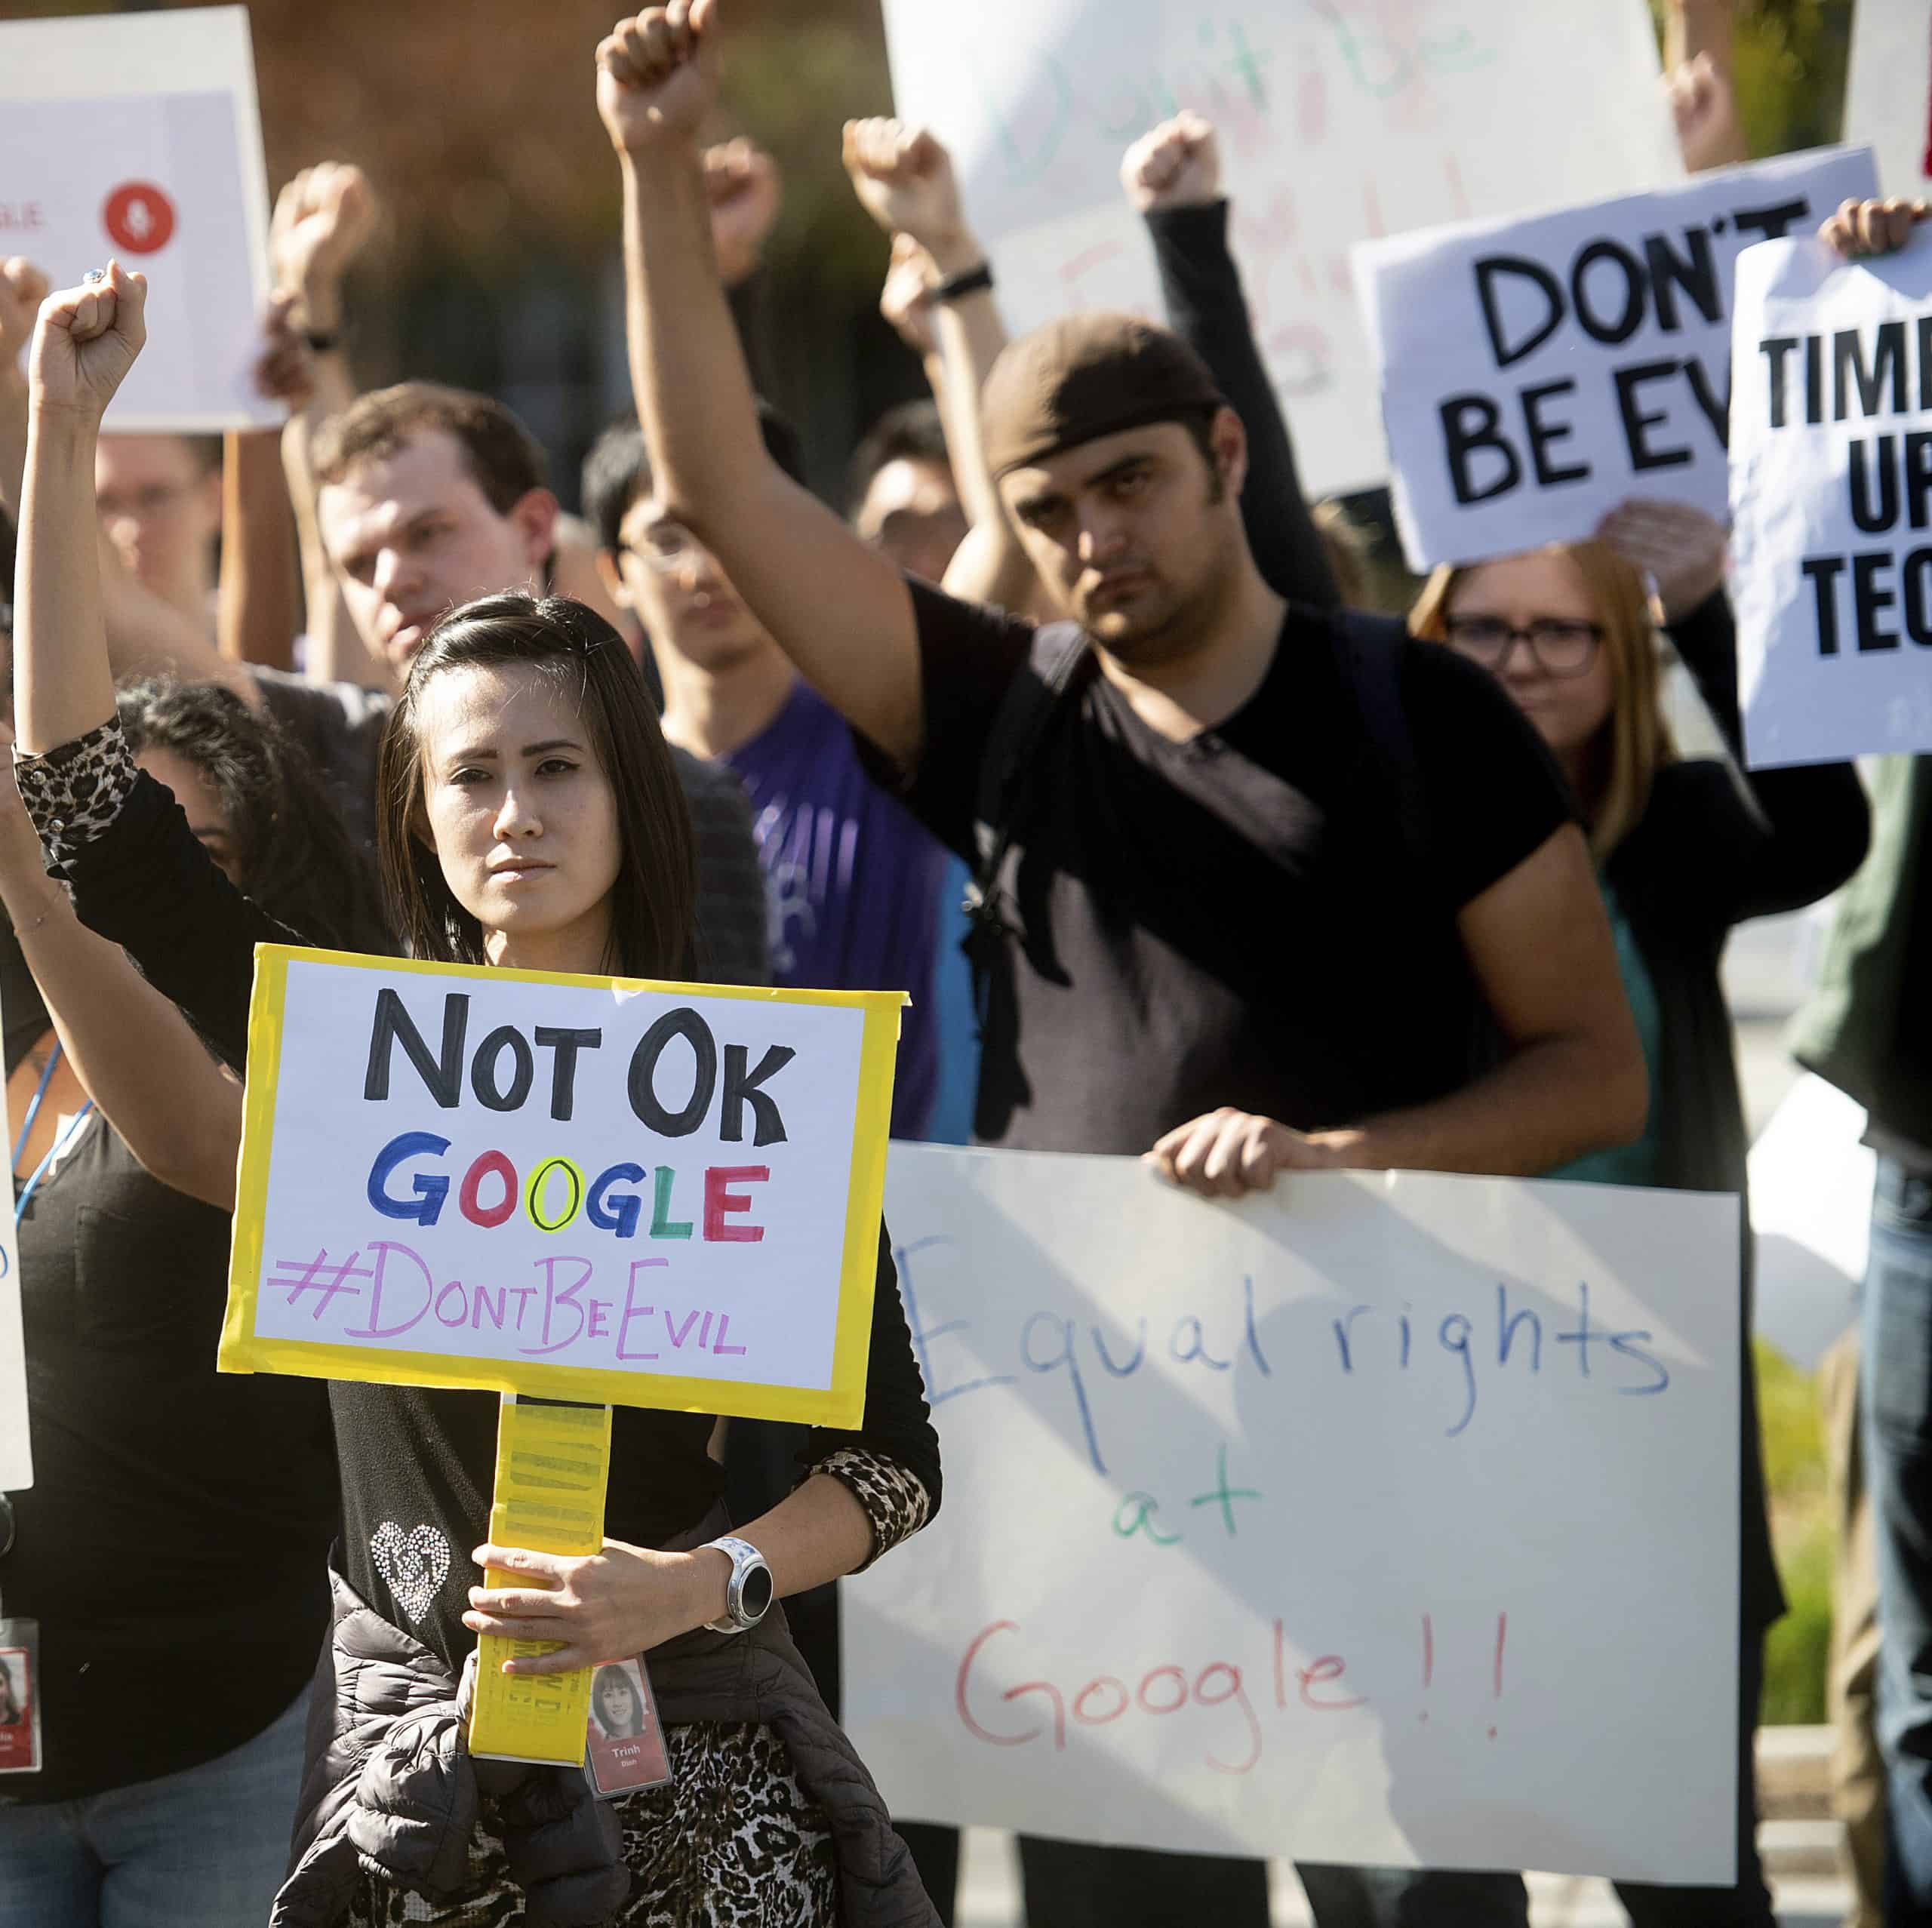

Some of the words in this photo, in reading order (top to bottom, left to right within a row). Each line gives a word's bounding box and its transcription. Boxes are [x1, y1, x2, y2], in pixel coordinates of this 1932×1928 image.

[1438, 380, 1591, 506] BE
[367, 1131, 771, 1242] GOOGLE
[896, 1234, 1272, 1477] Equal
[1334, 1281, 1670, 1438] rights
[1112, 1442, 1264, 1545] at
[611, 1744, 641, 1758] Trinh
